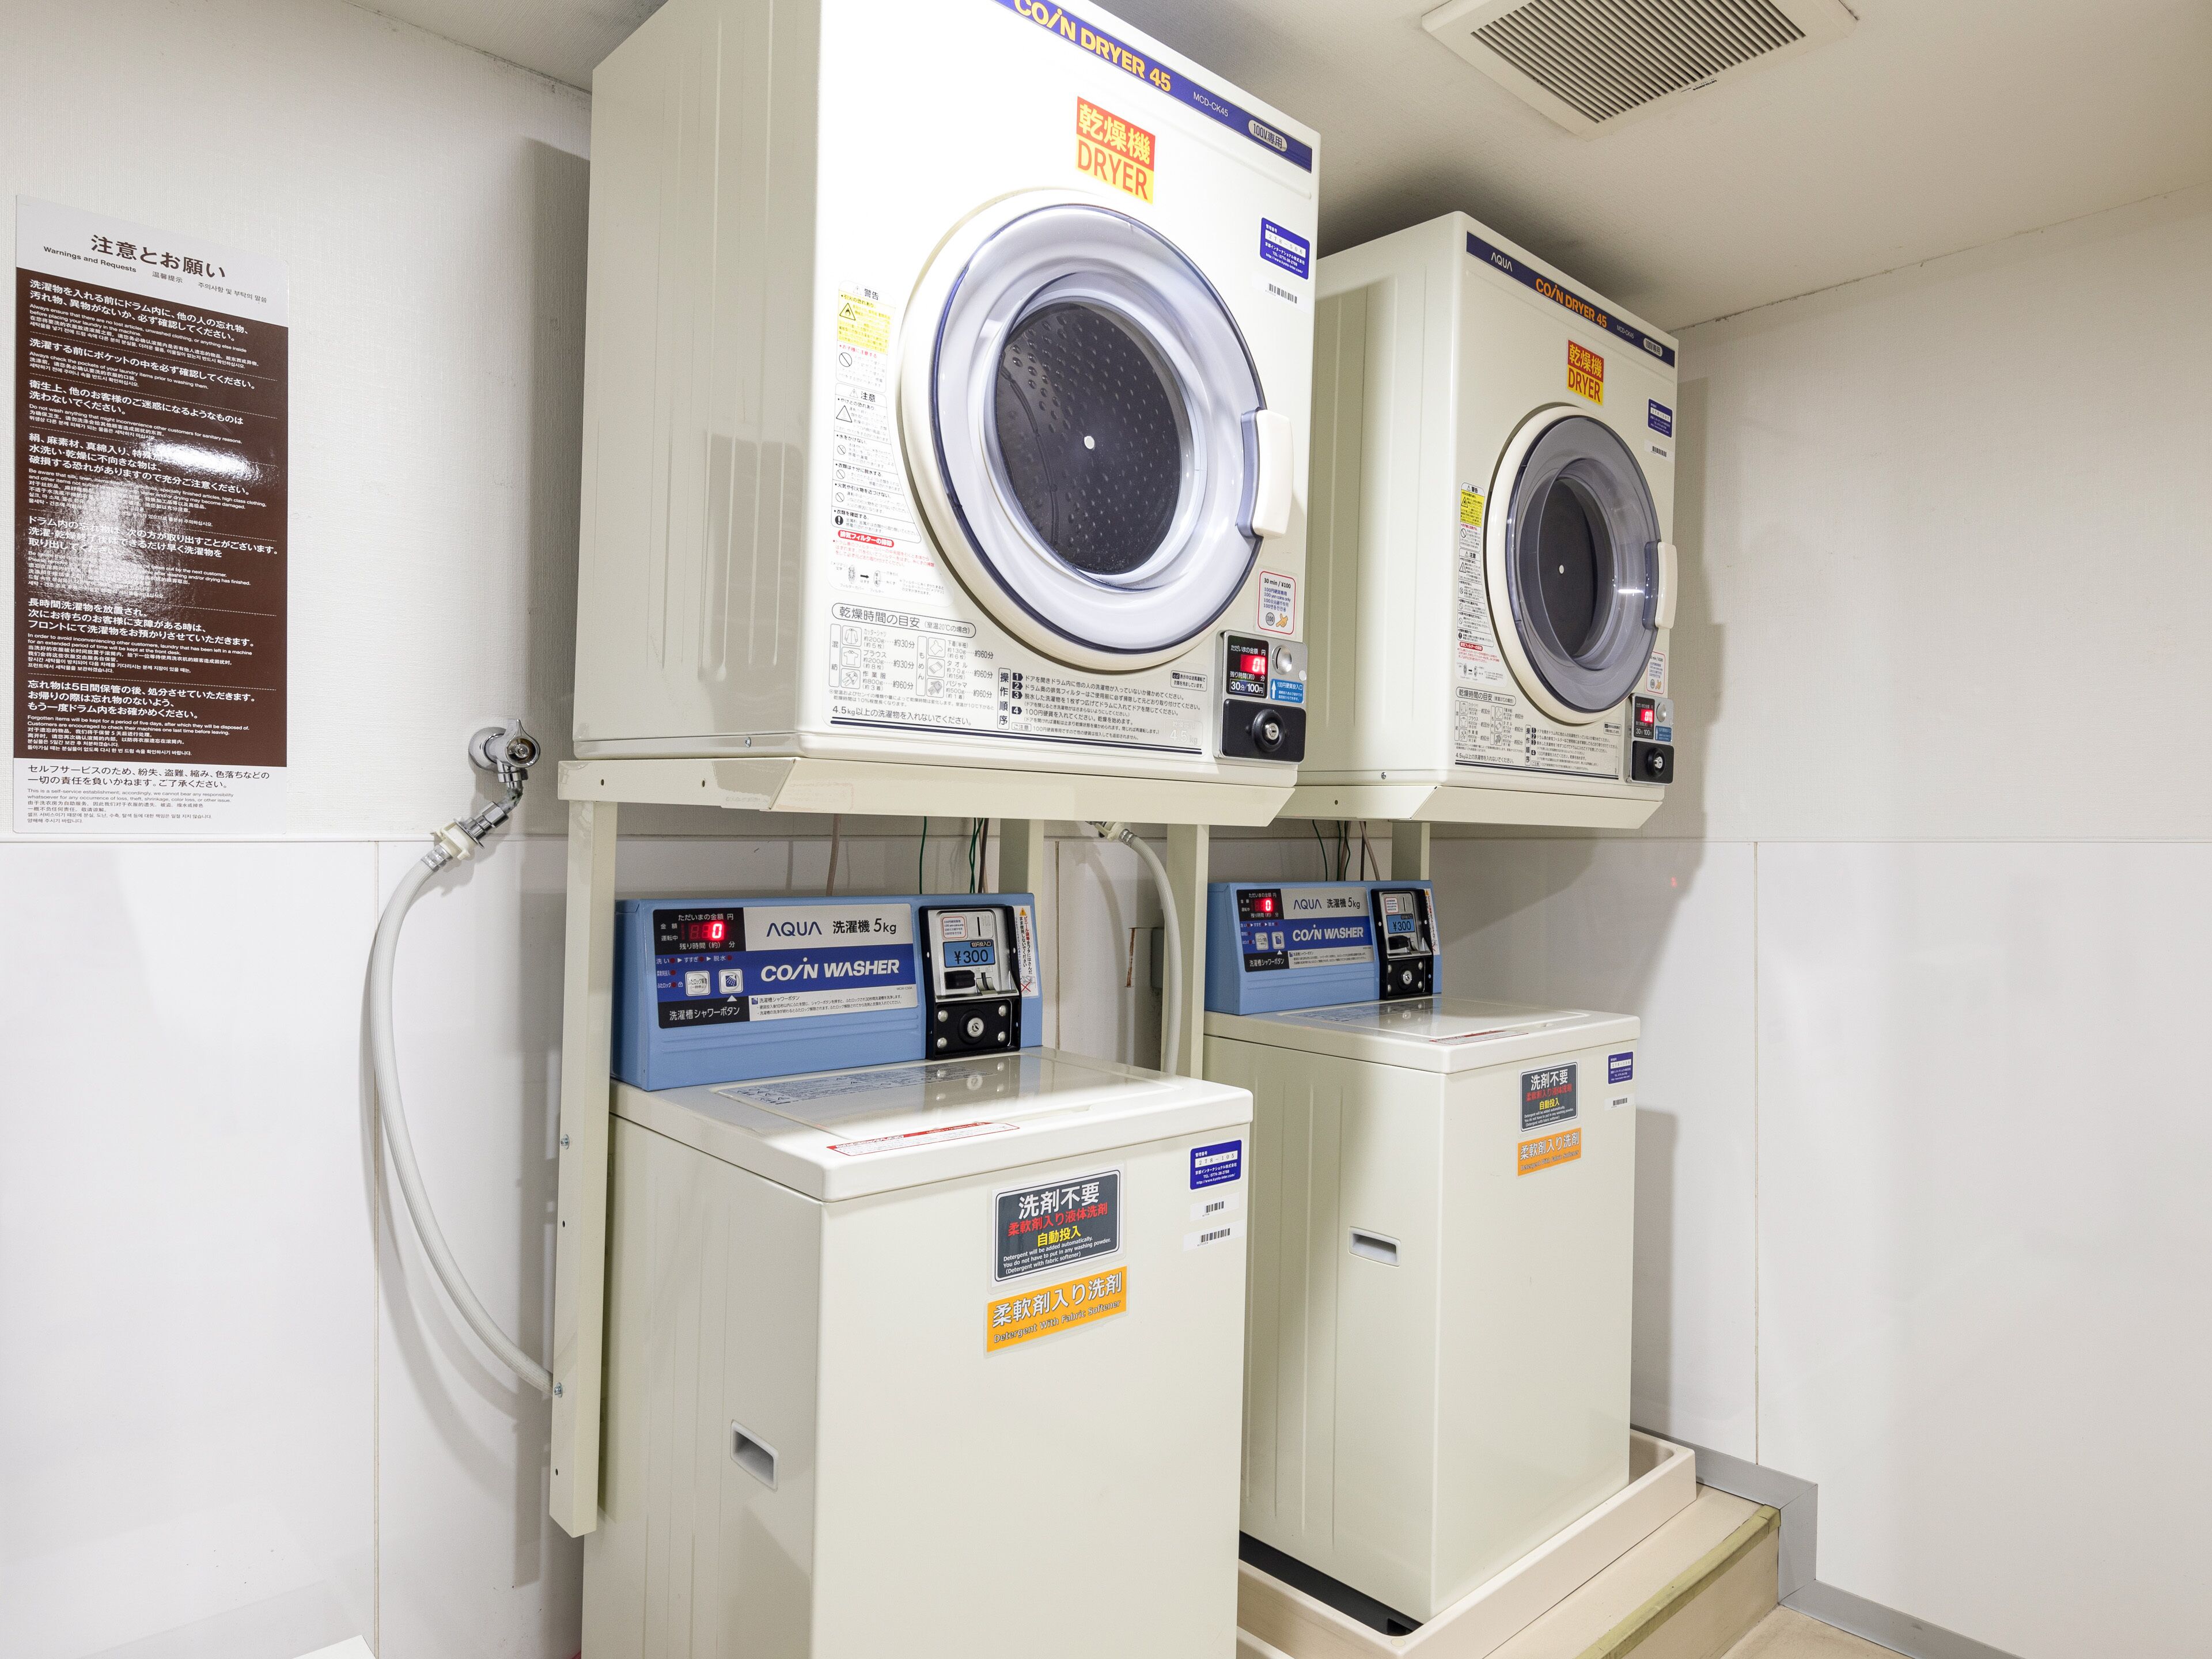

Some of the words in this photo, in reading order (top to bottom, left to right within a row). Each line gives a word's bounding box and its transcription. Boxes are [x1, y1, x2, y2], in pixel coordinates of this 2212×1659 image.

[1081, 28, 1145, 78] DRYER
[1150, 68, 1171, 92] 45
[1193, 91, 1229, 117] MCD-CK45
[1079, 104, 1150, 164] 乾燥機
[1078, 139, 1147, 200] DRYER
[43, 246, 81, 261] Warnings
[84, 255, 98, 264] and
[100, 259, 136, 274] Requests
[90, 233, 225, 282] 注意とお願い
[1491, 252, 1513, 272] AQUA
[152, 271, 183, 283] 温馨提示
[198, 281, 224, 293] 주의사항
[234, 290, 252, 300] 부탁의
[255, 295, 266, 303] 말씀
[864, 288, 879, 300] 警告
[29, 279, 248, 334] 洗濯物を入れる前にドラム内に、他の人の忘れ物、
[30, 290, 234, 342] 汚れ物、異物がないか、必ず確認してください。
[1565, 294, 1594, 321] DRYER
[1597, 313, 1607, 328] 45
[29, 309, 47, 317] before
[48, 313, 68, 322] placing
[82, 320, 102, 329] laundry
[118, 328, 142, 336] machine.
[29, 303, 49, 312] Always
[124, 323, 144, 332] articles,
[145, 328, 171, 337] unwashed
[172, 333, 193, 342] clothing,
[200, 339, 221, 348] anything
[29, 337, 255, 389] 洗濯する前にポケットの中を必ず確認してください。
[1569, 344, 1602, 378] 乾燥機
[861, 391, 875, 402] 注意
[1569, 370, 1600, 402] DRYER
[29, 378, 243, 425] 衛生上、他のお客様のご迷惑になるようなものは
[29, 389, 125, 415] 洗わないでください。
[28, 453, 249, 497] 破損する恐れがありますので充分ご注意ください。
[27, 597, 149, 619] 長時間洗濯物を放置され、
[839, 606, 919, 628] 乾燥時間の目安
[28, 607, 205, 632] 次にお待ちのお客様に支障がある時は、
[28, 619, 253, 647] フロントにて洗濯物をお預かりさせていただきます。
[893, 638, 915, 649] 約30分
[863, 649, 887, 658] ブラウス
[893, 659, 914, 669] 約30分
[974, 649, 994, 660] 約60分
[892, 680, 914, 690] 約60分
[946, 680, 967, 688] パジャマ
[974, 669, 993, 679] 約60分
[27, 679, 255, 702] 忘れ物は5日間保管の後、処分させていただきます。
[28, 690, 174, 707] お帰りの際は忘れ物のないよう、
[973, 689, 992, 698] 約60分
[1459, 689, 1493, 701] 乾燥時間の目安
[28, 701, 197, 719] もう一度ドラム内をお確かめください。
[832, 705, 971, 726] 4.5kg以上の洗濯物を入れないでください。
[28, 764, 270, 779] セルフサービスのため、紛失、盗難、縮み、色落ちなどの
[28, 775, 226, 788] 一切の責任を負いかねます。ご了承ください。
[1294, 898, 1322, 910] AQUA
[678, 913, 724, 922] ただいまの金額
[832, 919, 870, 934] 洗濯機
[1393, 921, 1411, 931] ¥300
[711, 923, 722, 938] 0
[766, 921, 822, 937] AQUA
[1324, 927, 1364, 939] WASHER
[953, 949, 989, 964] ¥300
[823, 959, 900, 978] WASHER
[669, 1005, 740, 1021] 洗濯槽シャワーボタン
[1531, 1069, 1568, 1091] 洗剤不要
[1539, 1097, 1560, 1110] 自動投入
[1520, 1131, 1580, 1161] 柔軟剤入り洗剤
[1018, 1180, 1099, 1219] 洗剤不要
[1008, 1202, 1107, 1236] 柔軟剤入り液体洗剤
[1037, 1225, 1080, 1247] 自動投入
[1003, 1251, 1028, 1262] Detergent
[1046, 1243, 1060, 1251] added
[1061, 1235, 1093, 1249] automatically.
[1013, 1257, 1020, 1266] do
[1031, 1253, 1042, 1262] have
[1074, 1241, 1093, 1253] washing
[1093, 1237, 1111, 1247] powder.
[1005, 1263, 1032, 1275] (Detergent
[1045, 1256, 1059, 1264] fabric
[1059, 1251, 1081, 1263] softener)
[992, 1271, 1121, 1328] 柔軟剤入り洗剤
[994, 1324, 1036, 1344] Detergent
[1040, 1317, 1058, 1330] With
[1060, 1309, 1085, 1323] Fabric
[1088, 1299, 1120, 1315] Softener
